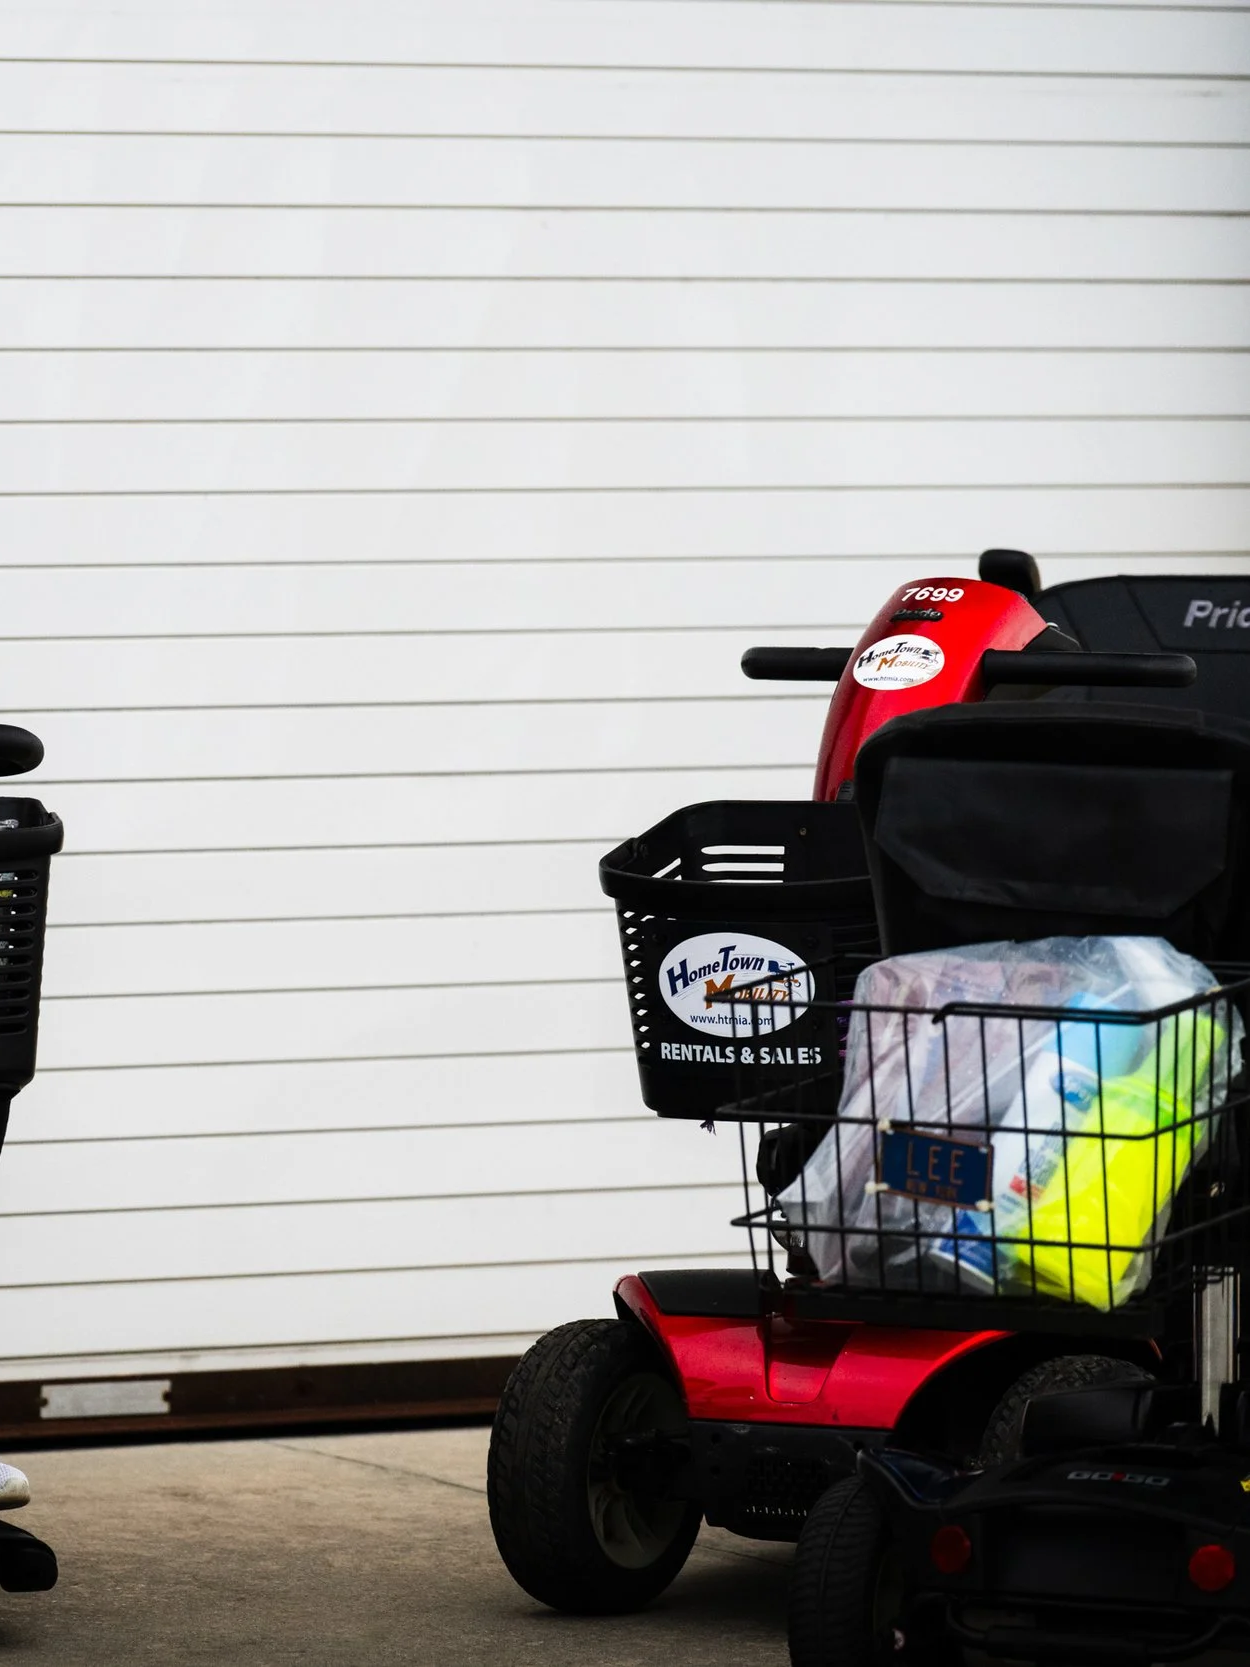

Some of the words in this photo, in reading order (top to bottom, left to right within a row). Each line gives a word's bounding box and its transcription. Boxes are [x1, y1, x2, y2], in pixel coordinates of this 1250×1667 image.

[901, 586, 965, 603] 7699
[666, 944, 765, 998] HomeTown
[690, 1012, 775, 1027] www.htmia.om
[660, 1042, 735, 1064] RENTALS
[740, 1045, 756, 1065] &
[759, 1046, 822, 1065] SALES
[906, 1140, 965, 1186] LEE
